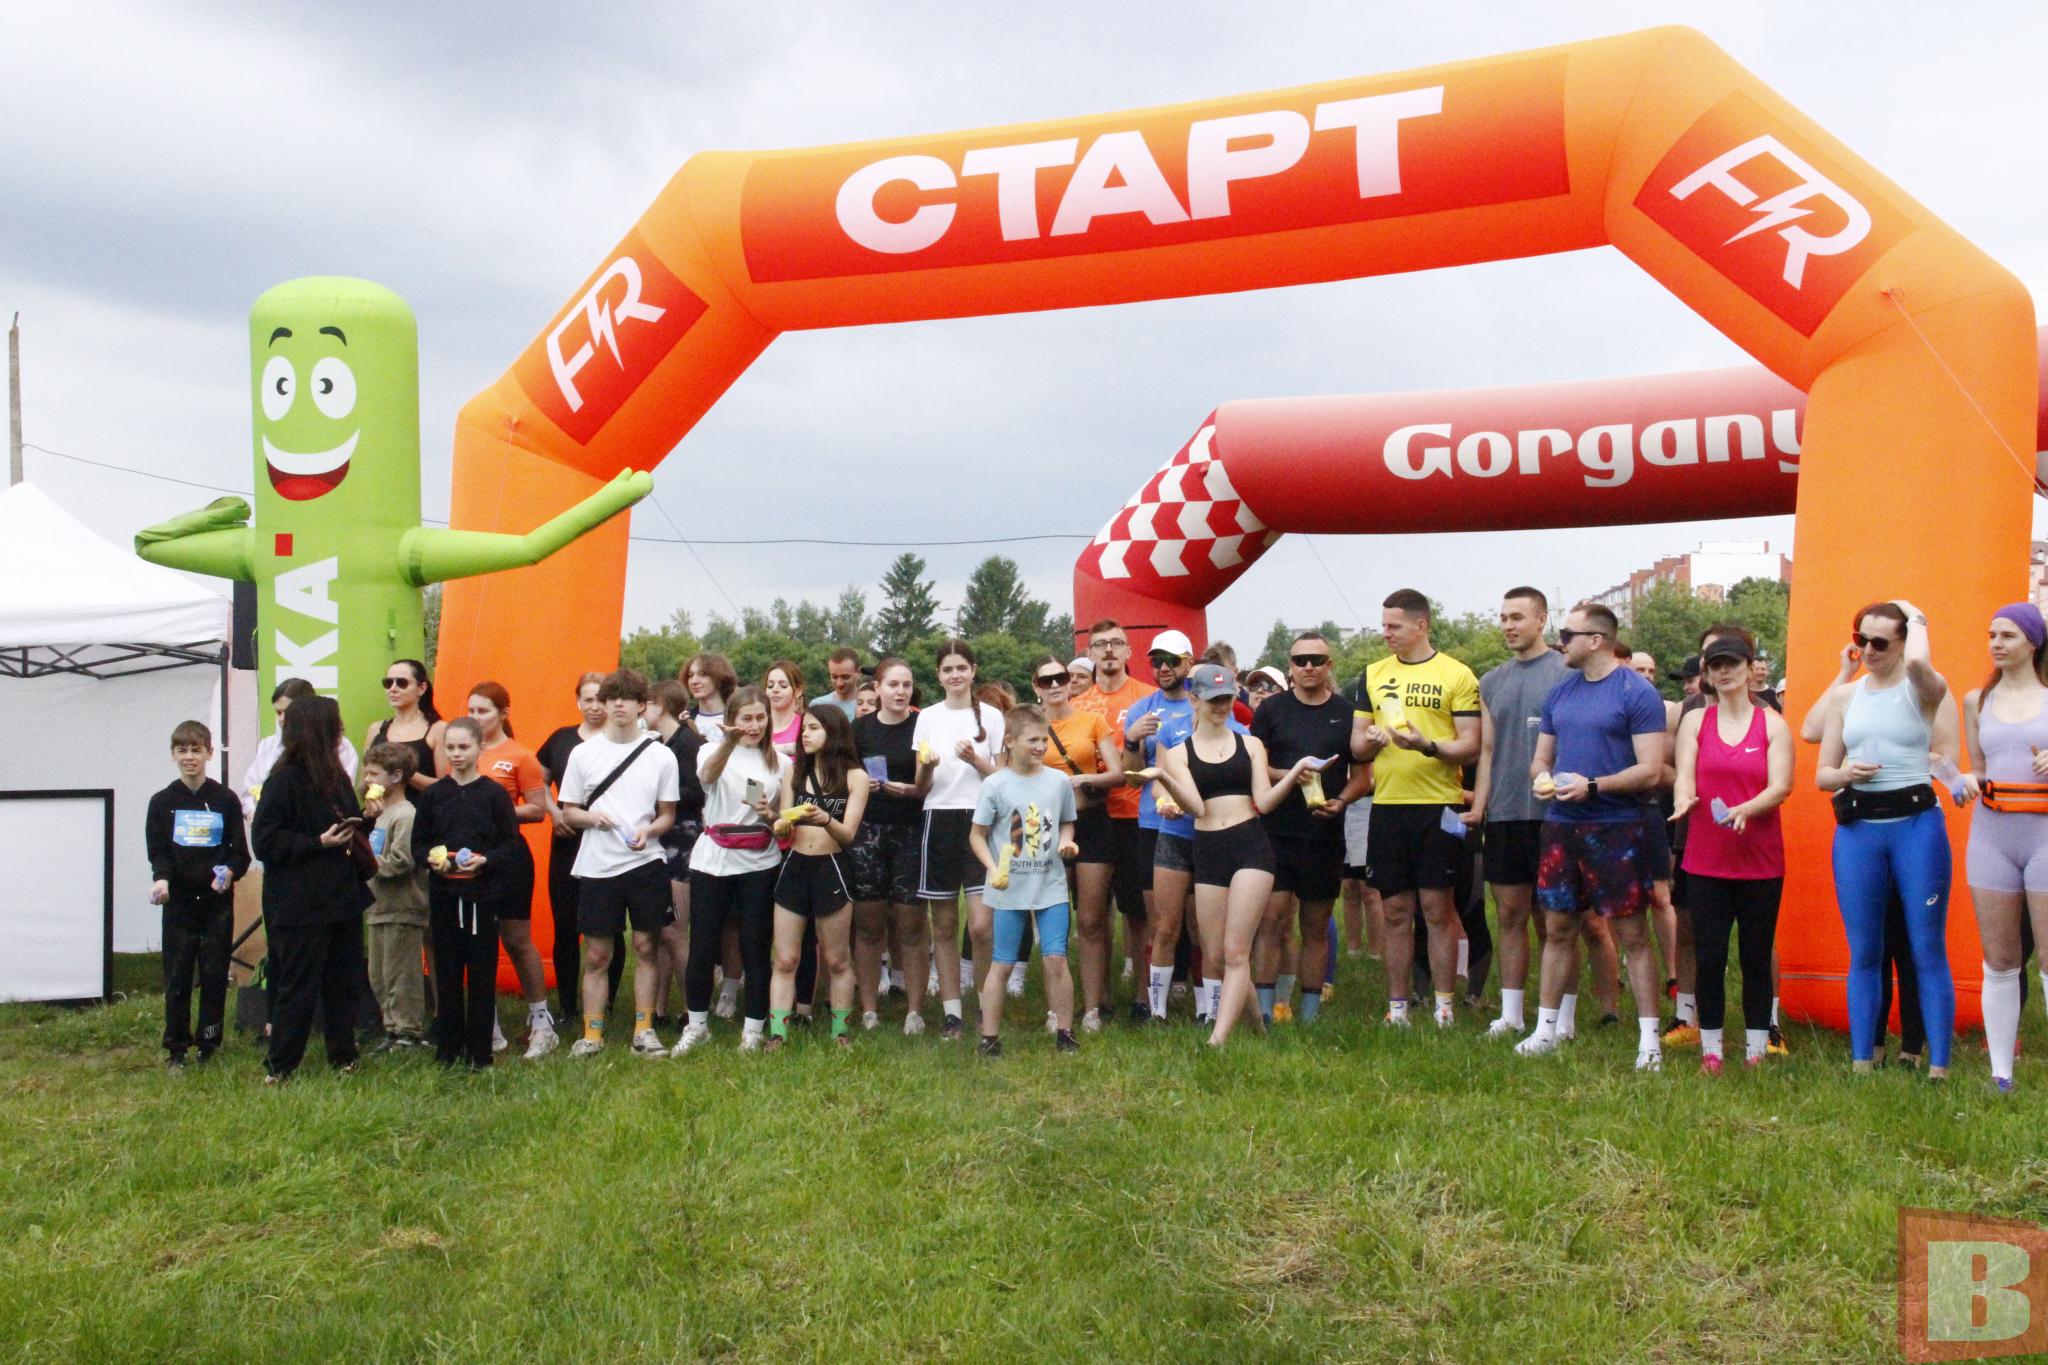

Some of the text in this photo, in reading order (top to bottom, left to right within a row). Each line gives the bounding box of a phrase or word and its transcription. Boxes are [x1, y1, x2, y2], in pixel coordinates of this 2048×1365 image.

[835, 85, 1445, 254] СТАРТ
[1406, 683, 1442, 696] IRON
[1405, 696, 1441, 709] CLUB
[1010, 860, 1032, 868] OUTH
